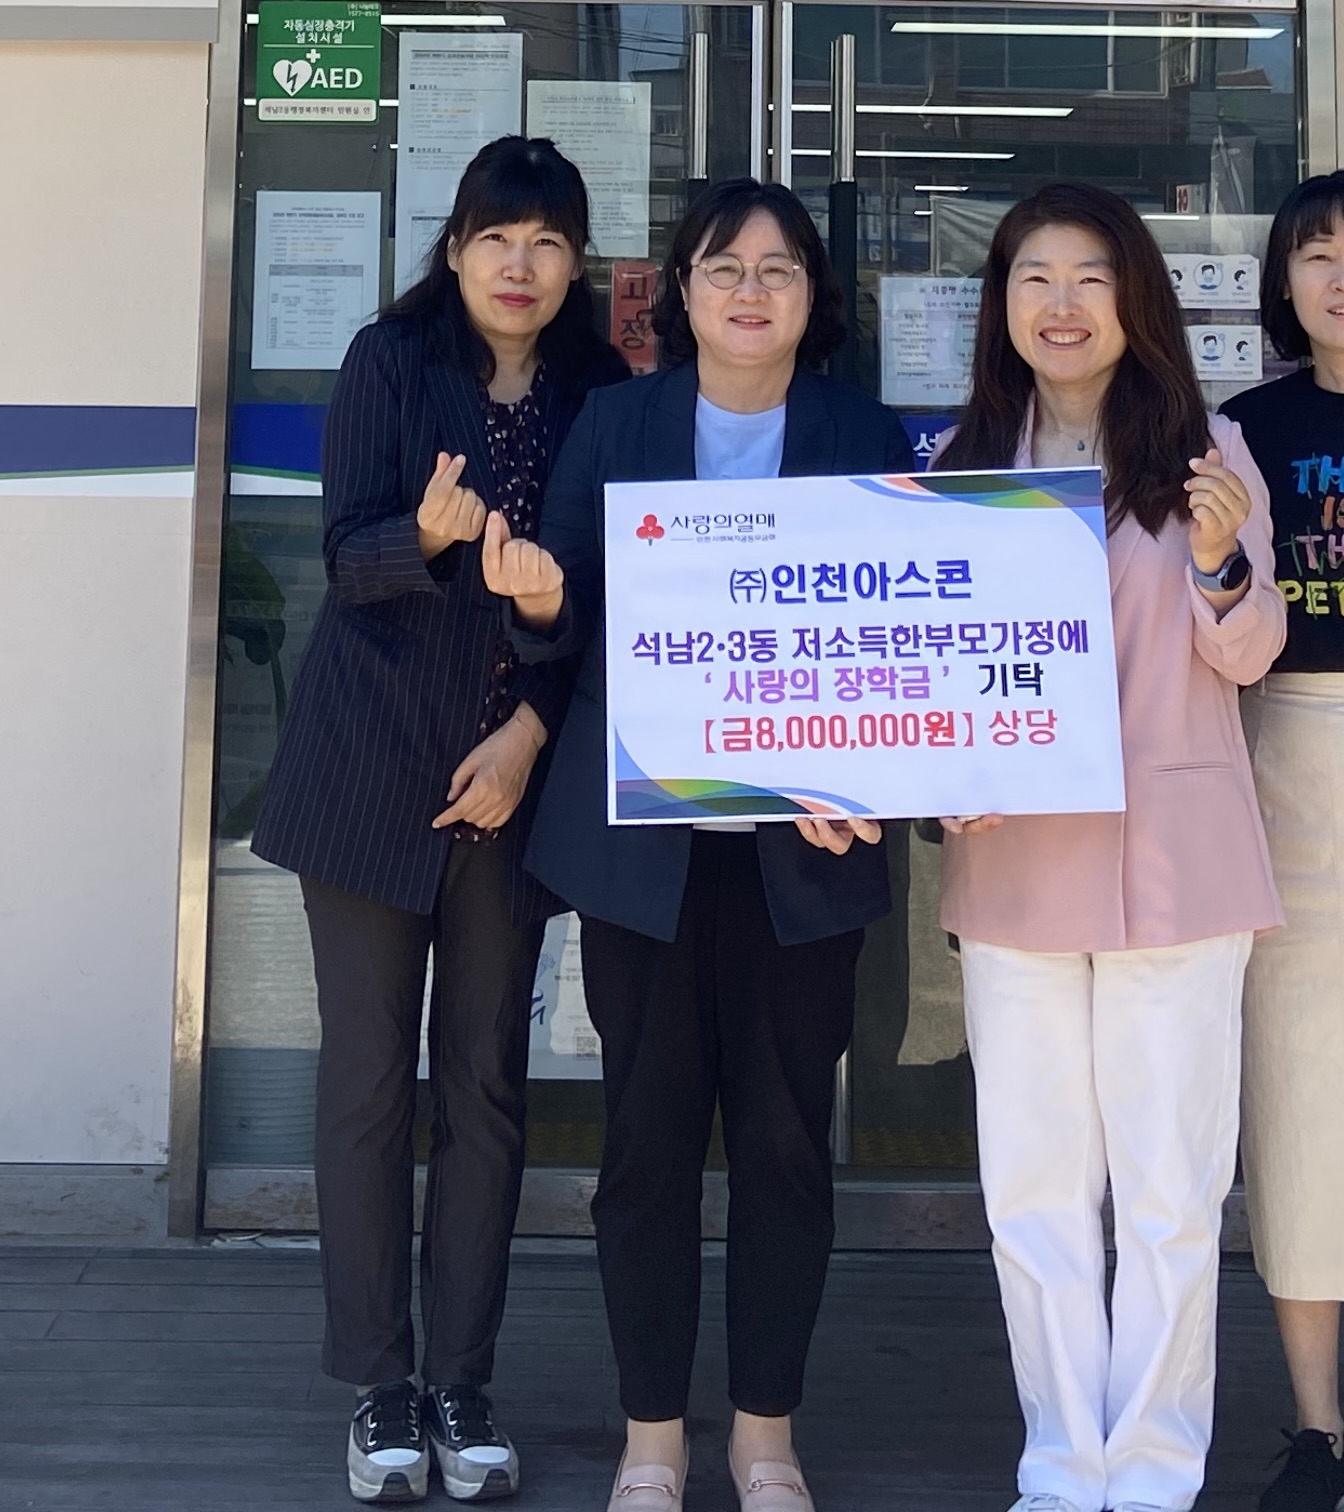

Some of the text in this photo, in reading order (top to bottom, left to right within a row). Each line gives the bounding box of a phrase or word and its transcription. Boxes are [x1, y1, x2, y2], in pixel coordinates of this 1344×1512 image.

[296, 32, 343, 44] 설치시설
[311, 68, 363, 88] AED
[792, 618, 1089, 661] 저소득한부모가정에
[978, 662, 1044, 698] 기탁
[989, 709, 1058, 746] 상당
